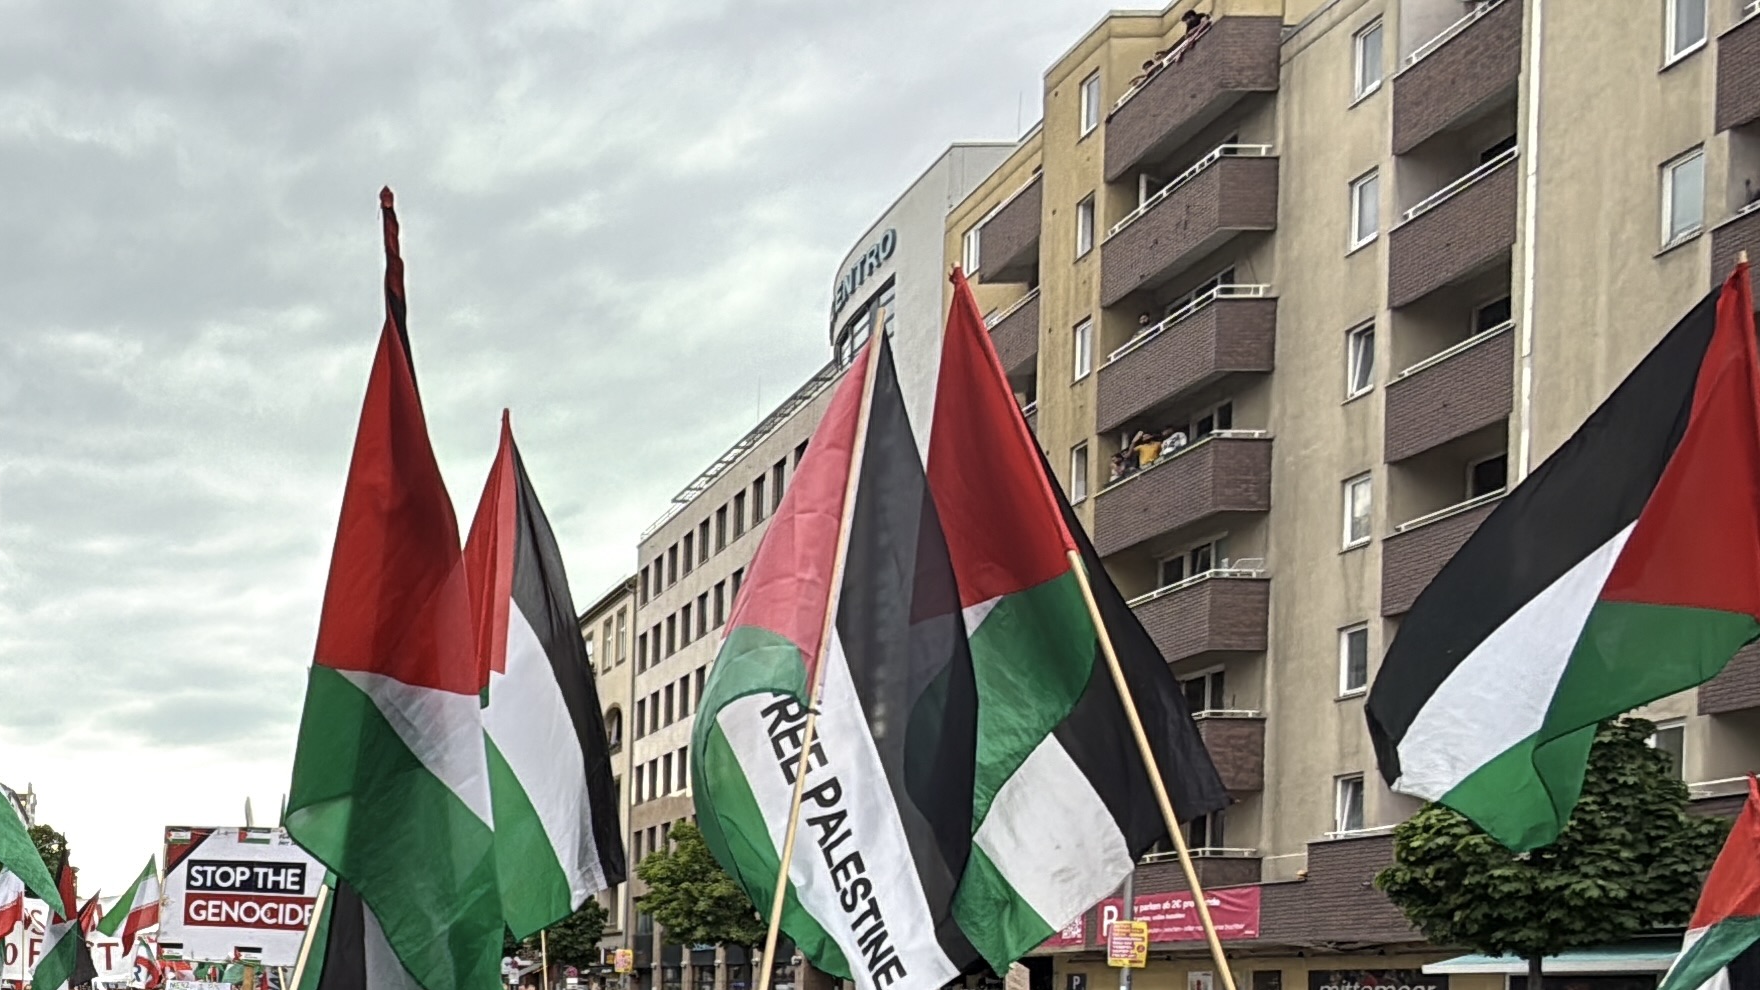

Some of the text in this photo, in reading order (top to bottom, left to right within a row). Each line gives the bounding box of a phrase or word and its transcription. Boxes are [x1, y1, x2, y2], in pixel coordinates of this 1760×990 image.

[760, 692, 829, 786] REE
[190, 866, 301, 890] STOP THE
[1073, 975, 1081, 990] P
